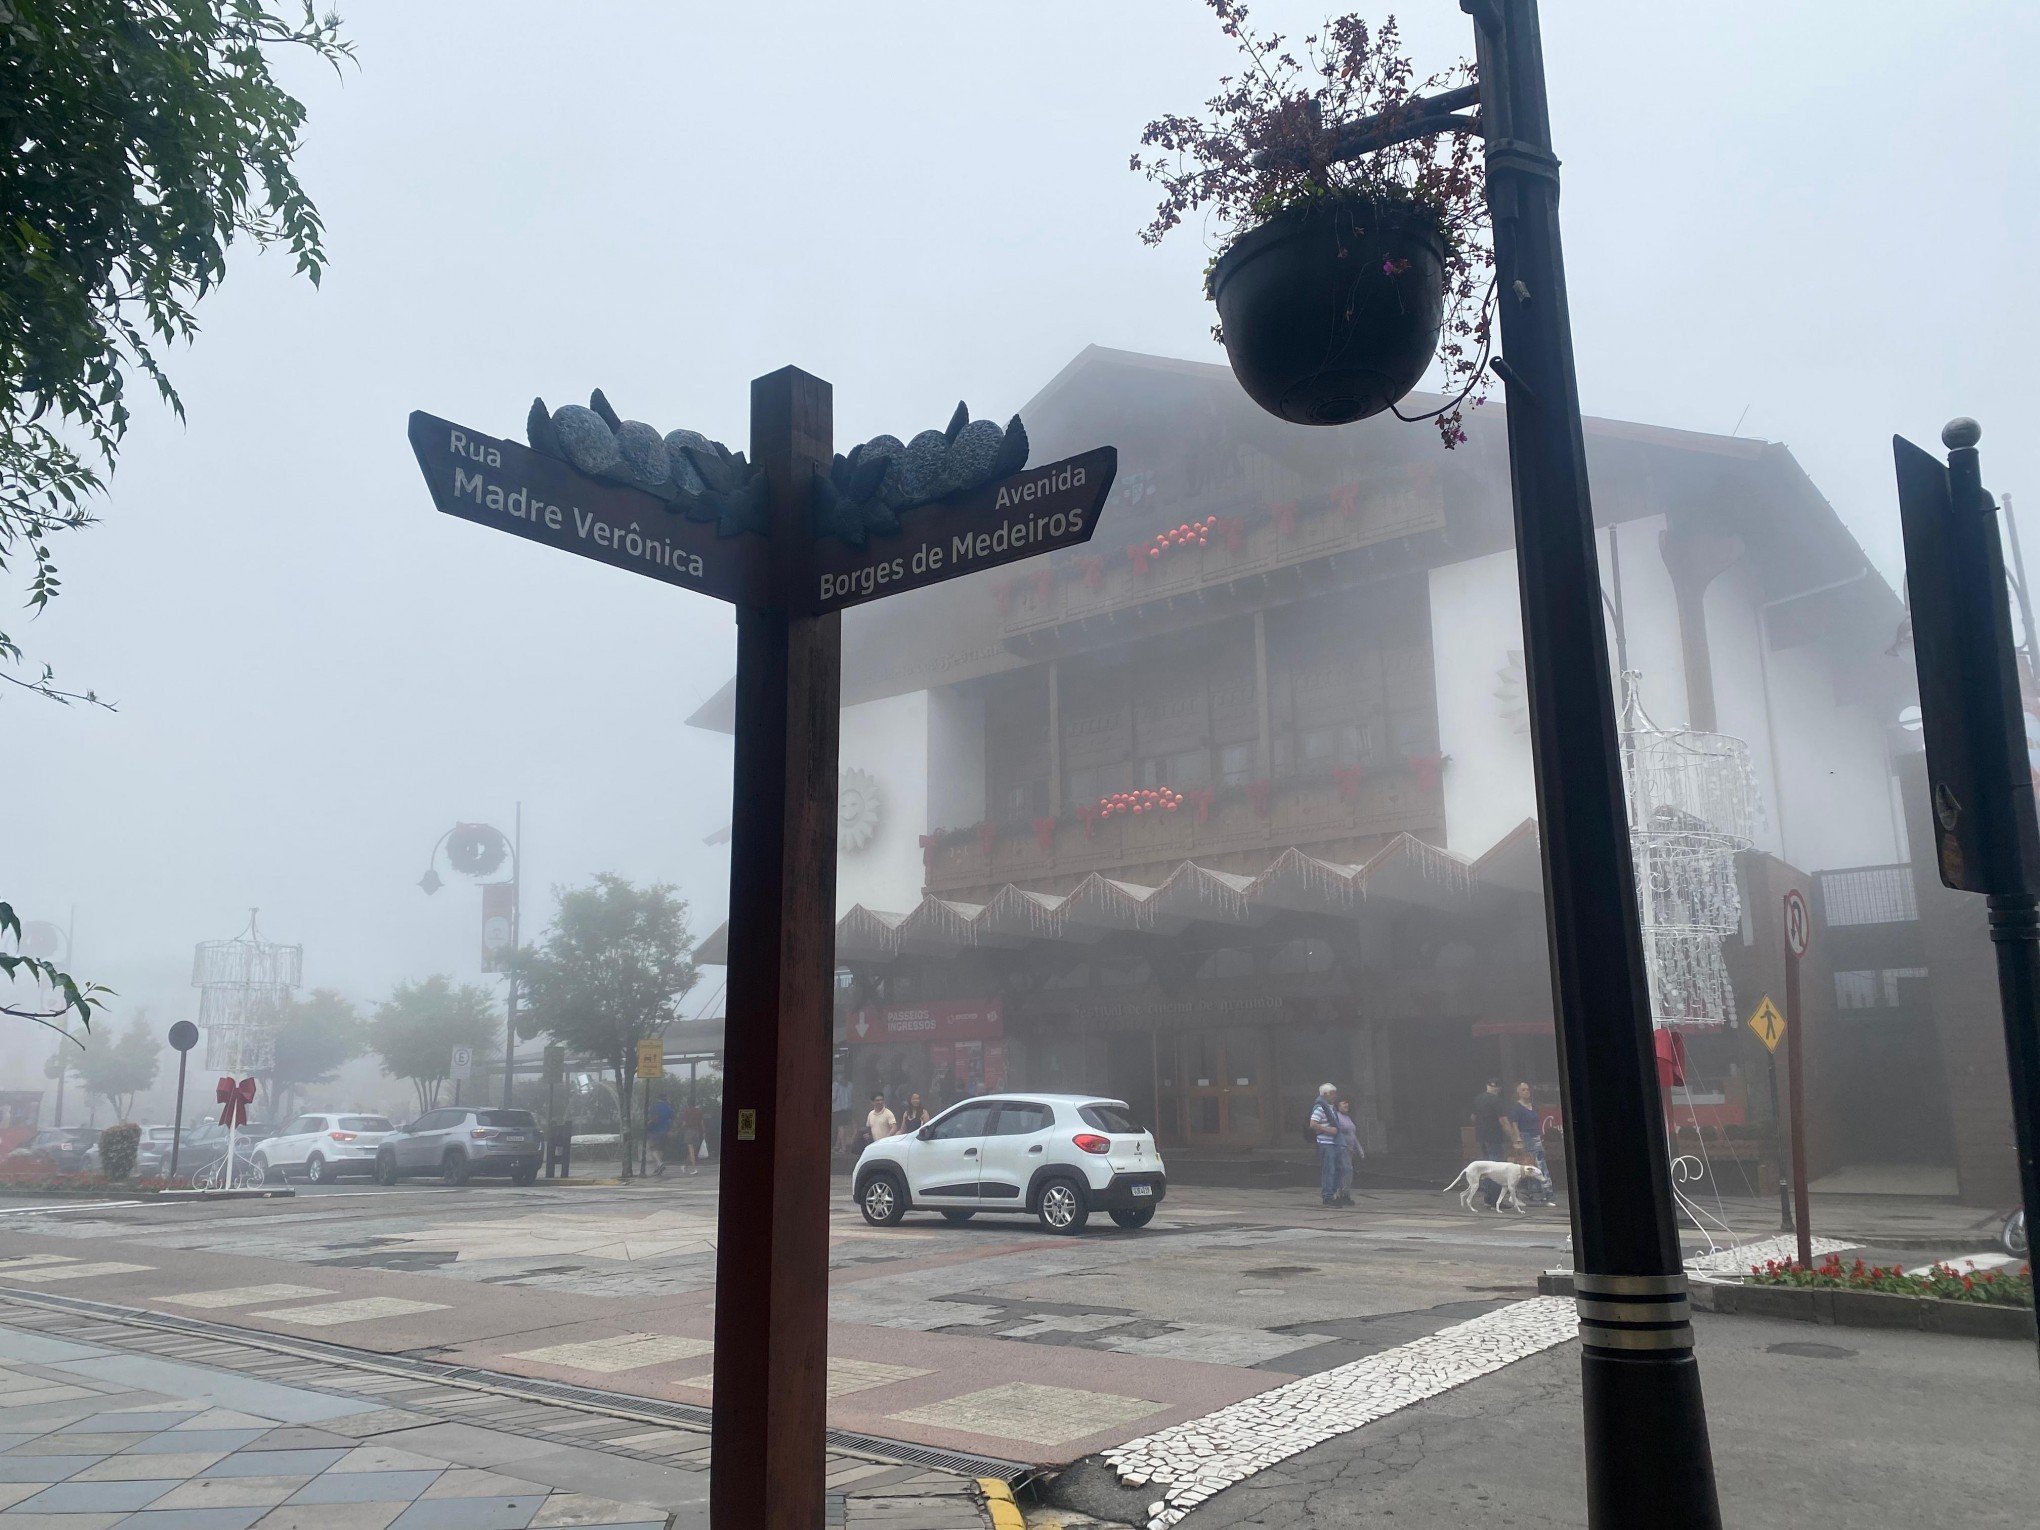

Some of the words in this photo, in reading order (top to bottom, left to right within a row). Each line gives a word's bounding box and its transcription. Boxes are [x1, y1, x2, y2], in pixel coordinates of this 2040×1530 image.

[450, 429, 501, 468] Rua
[995, 465, 1086, 510] Avenida
[454, 467, 562, 530] Madre
[573, 506, 704, 577] Verônica
[820, 557, 904, 600] Borges
[912, 543, 943, 574] de
[952, 507, 1083, 563] Medeiros
[887, 1010, 930, 1022] PASSEIOS
[887, 1020, 937, 1032] INGRESSOS
